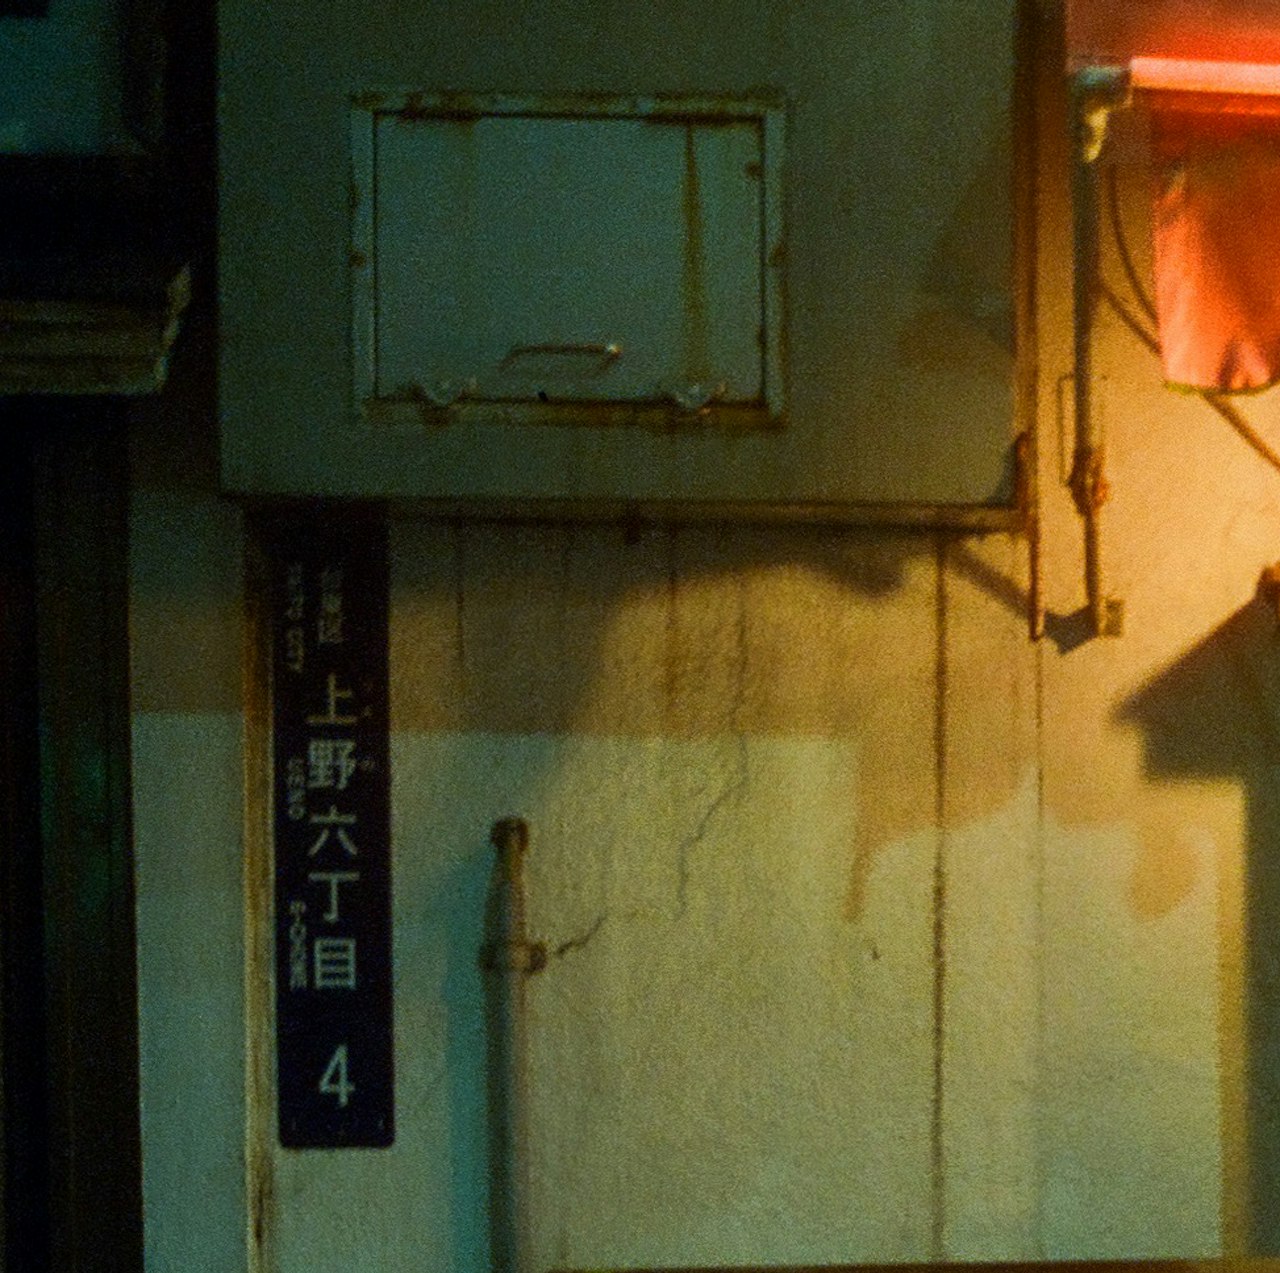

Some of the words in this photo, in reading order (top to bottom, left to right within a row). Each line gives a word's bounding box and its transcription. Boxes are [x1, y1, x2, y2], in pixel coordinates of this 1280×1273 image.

[306, 673, 360, 990] 上野六丁目
[317, 1043, 356, 1108] 4
